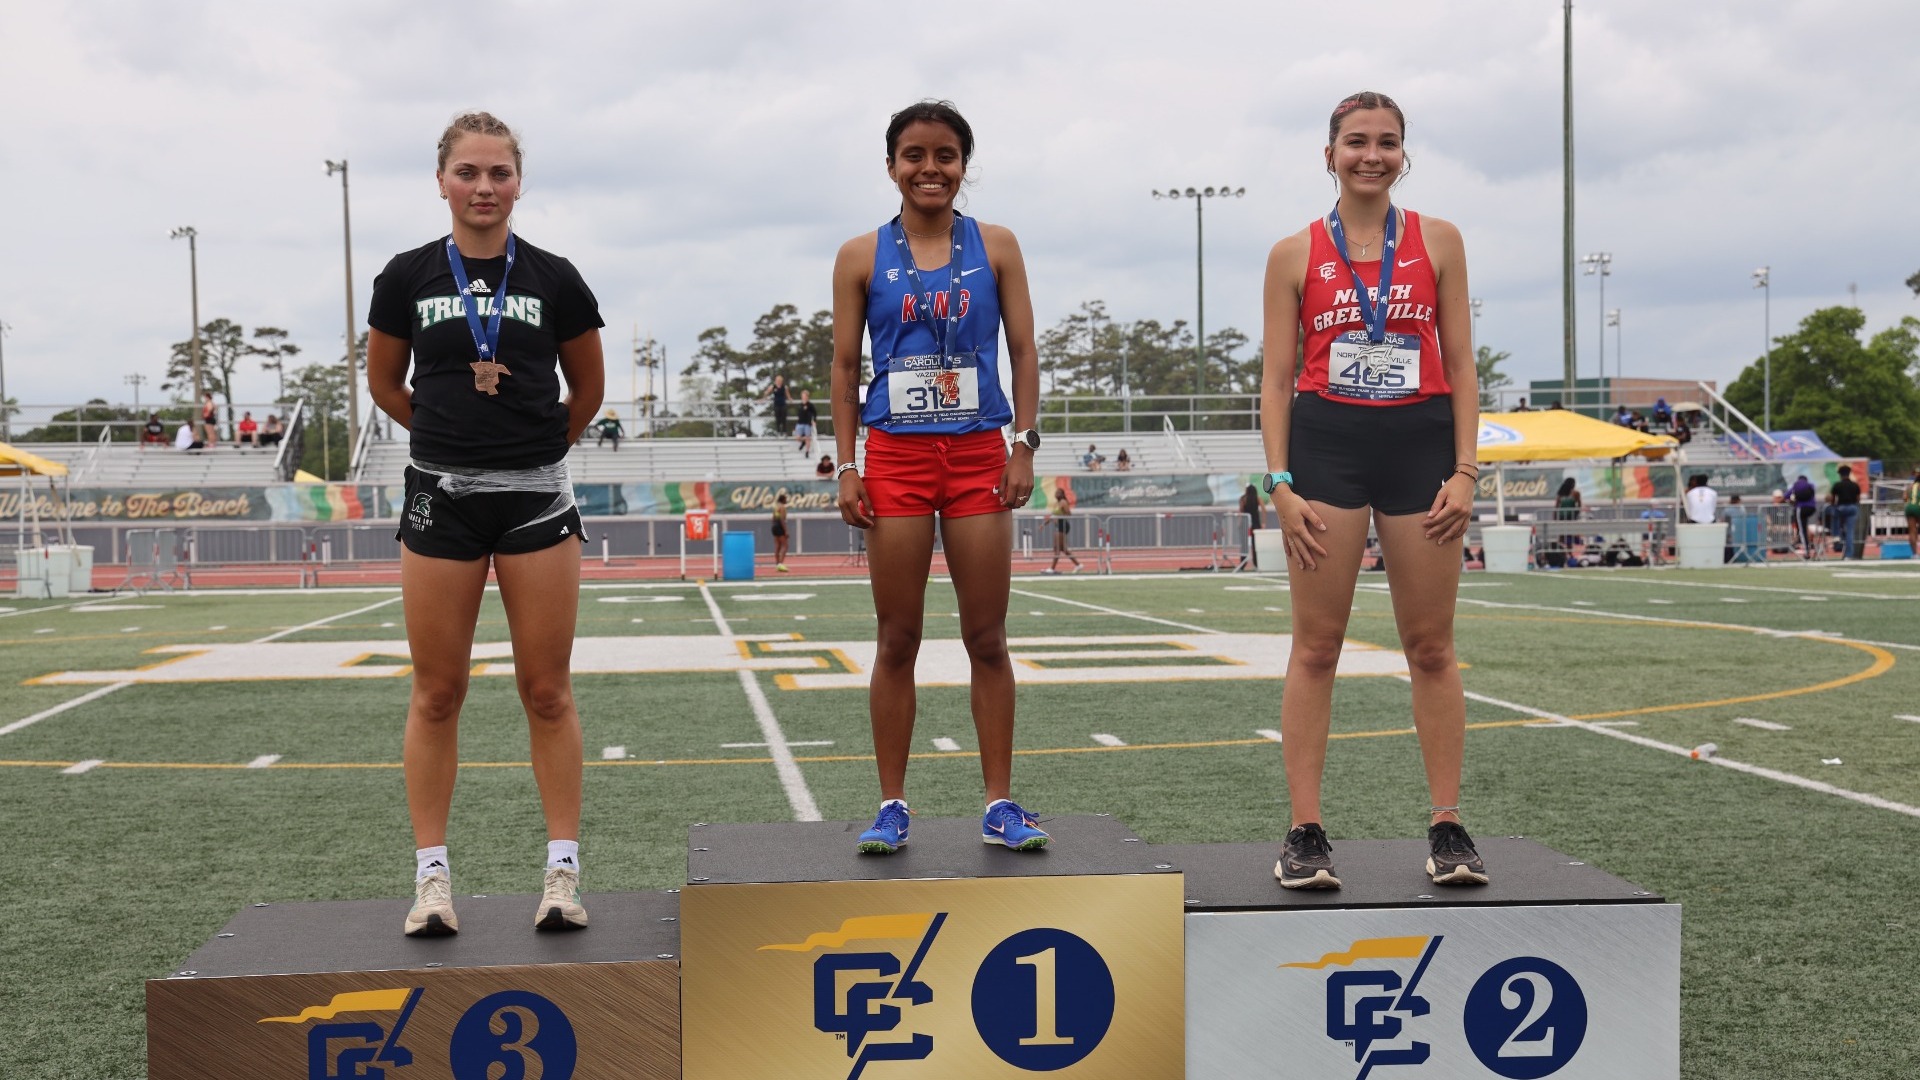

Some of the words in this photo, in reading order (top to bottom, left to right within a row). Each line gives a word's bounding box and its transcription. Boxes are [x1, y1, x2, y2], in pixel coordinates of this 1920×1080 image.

[902, 289, 971, 323] KNG
[1333, 285, 1413, 306] NORTH
[1313, 302, 1433, 332] GREEVILLE
[1348, 331, 1406, 345] CARNAS
[904, 357, 963, 369] CAROLIS
[1337, 351, 1358, 359] NORT
[906, 386, 961, 411] 318
[1479, 473, 1549, 499] Beach
[101, 495, 123, 517] to
[126, 493, 170, 518] The
[173, 491, 251, 518] Beach
[1015, 946, 1075, 1047] 1
[1497, 970, 1555, 1058] 2
[486, 1005, 544, 1080] 3
